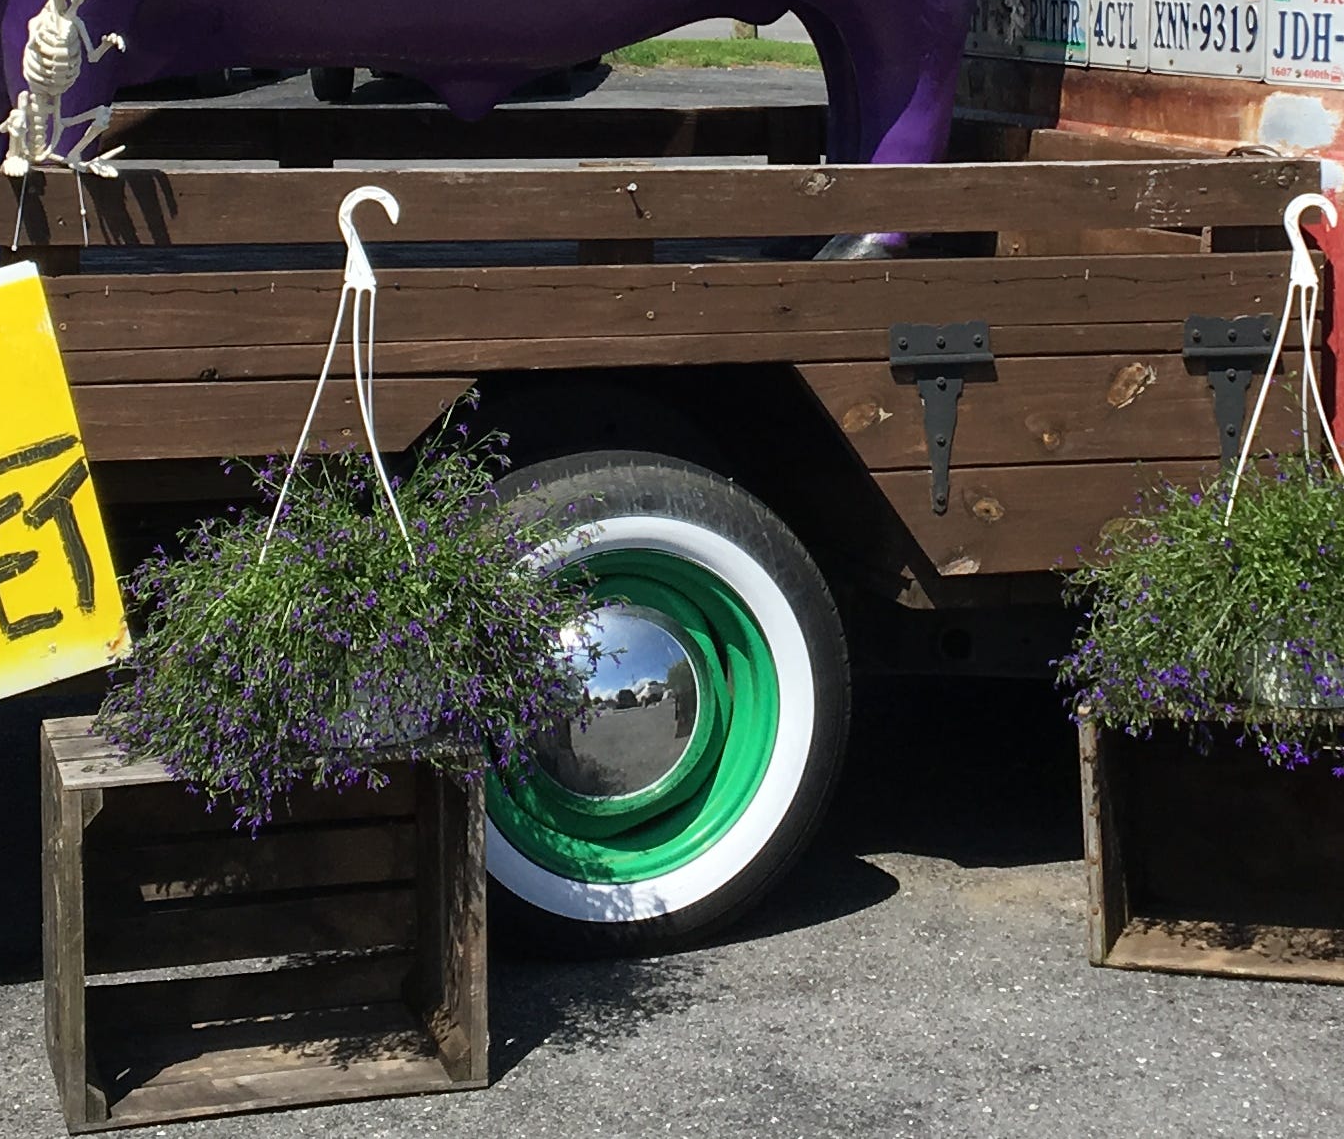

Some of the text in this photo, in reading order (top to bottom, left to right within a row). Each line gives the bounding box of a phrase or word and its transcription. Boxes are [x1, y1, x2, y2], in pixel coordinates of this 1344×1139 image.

[1093, 0, 1138, 50] 4CYL
[1153, 0, 1258, 53] XNN-9319
[1271, 66, 1292, 77] 1607
